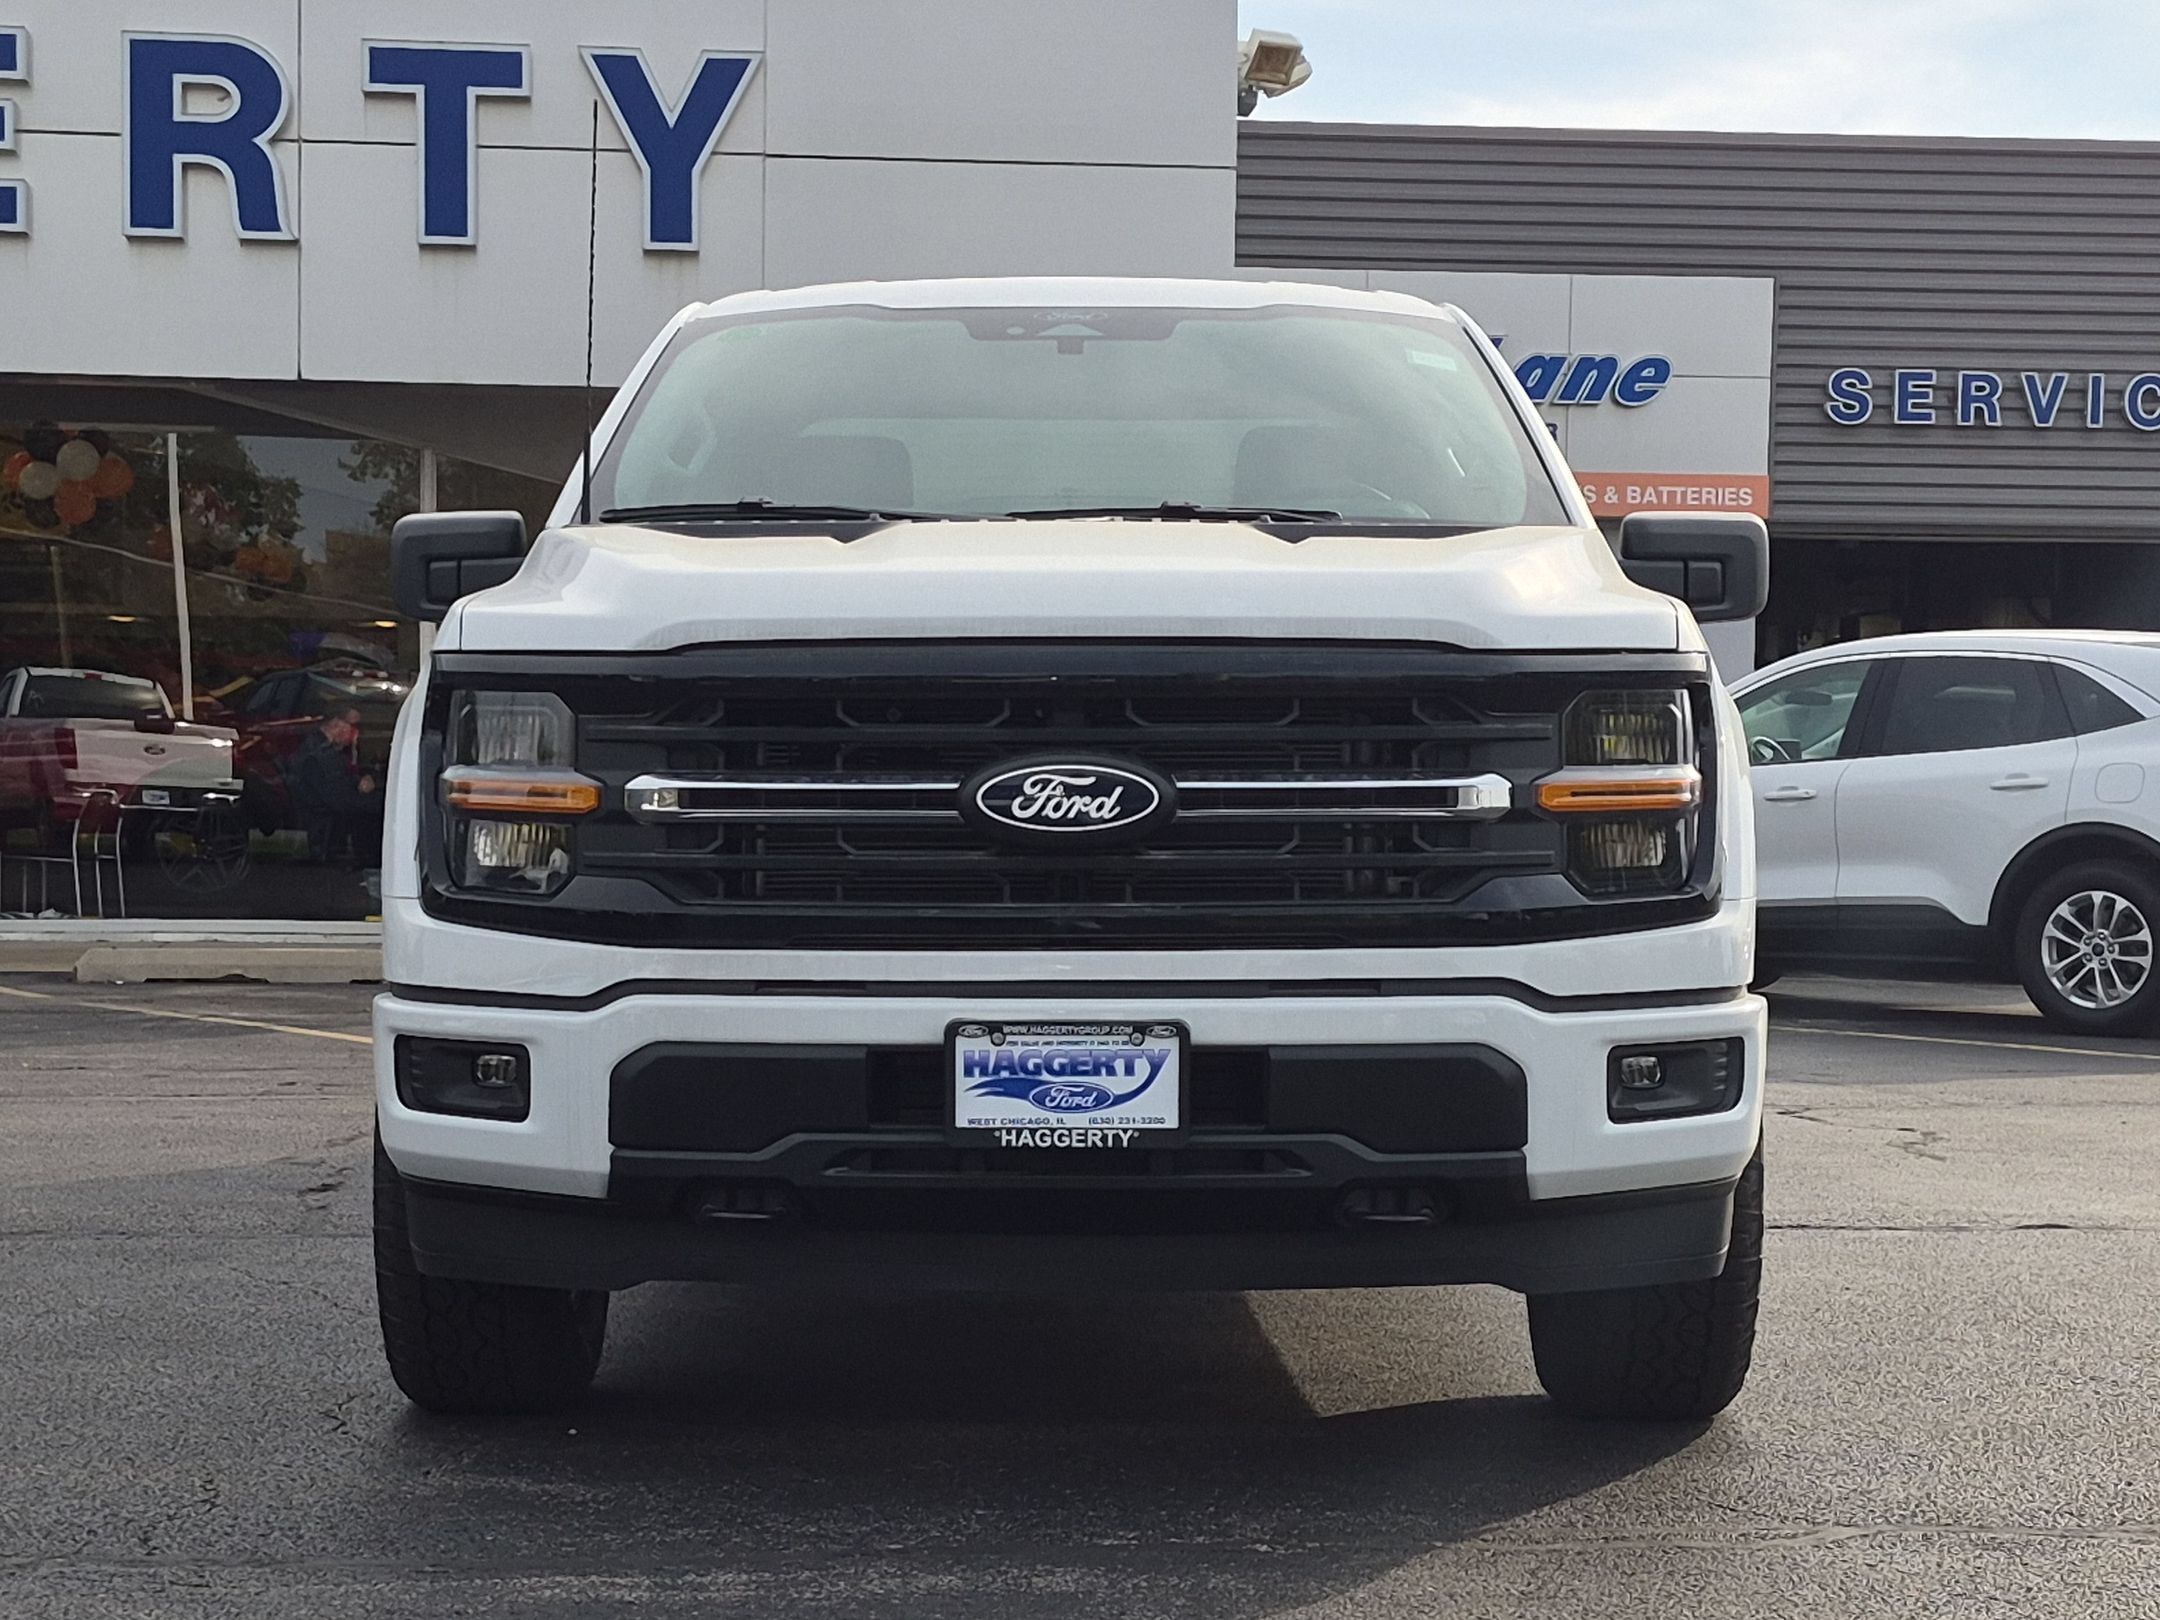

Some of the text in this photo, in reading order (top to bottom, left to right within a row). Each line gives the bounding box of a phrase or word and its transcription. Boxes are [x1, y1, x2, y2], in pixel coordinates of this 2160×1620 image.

[0, 25, 763, 253] RTY
[1491, 334, 1673, 407] ane
[1603, 486, 1619, 504] &
[1626, 486, 1753, 506] BATTERIES
[1011, 773, 1124, 820] Ford
[963, 1049, 1171, 1078] HAGGERTY
[967, 1117, 997, 1126] WEST
[1001, 1117, 1053, 1126] CHICAGO,
[1001, 1129, 1133, 1148] HAGGERTY
